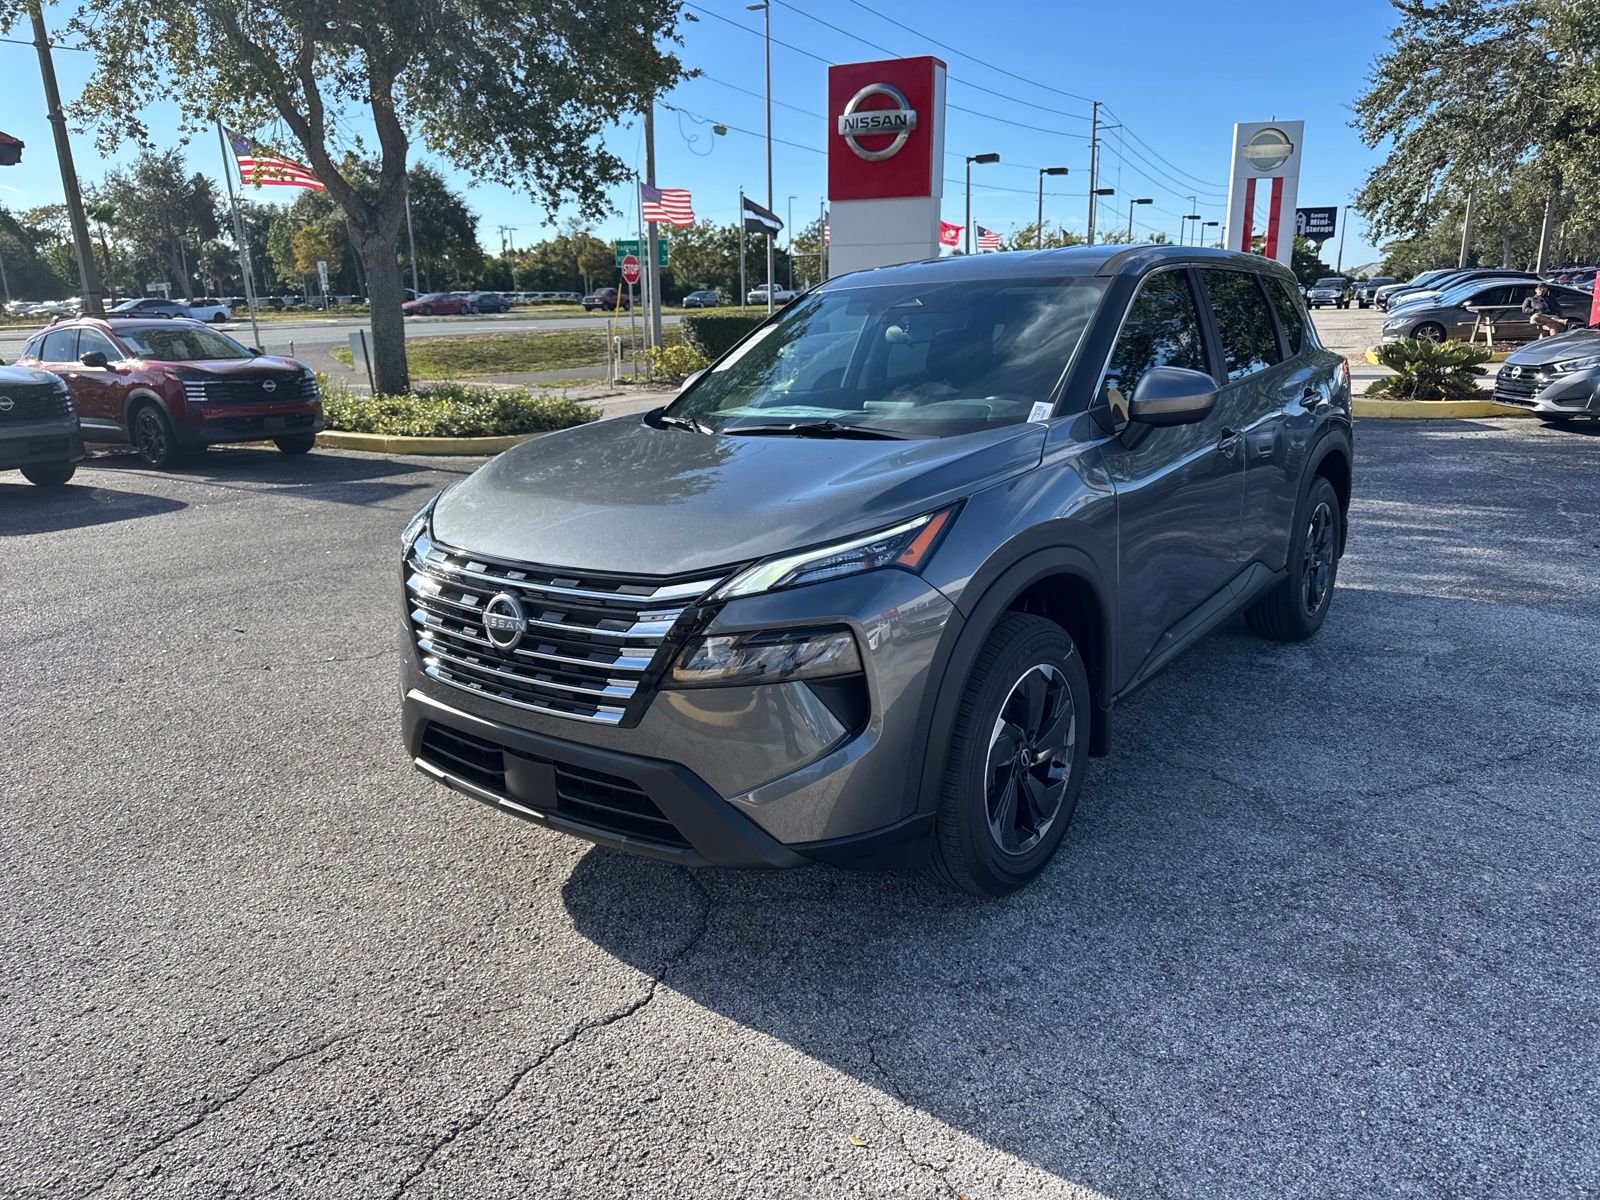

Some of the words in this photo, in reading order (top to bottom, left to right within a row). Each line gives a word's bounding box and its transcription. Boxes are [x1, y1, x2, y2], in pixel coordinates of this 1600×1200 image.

[844, 114, 907, 130] NISSAN
[623, 264, 640, 275] STOP
[486, 616, 525, 631] SSAN
